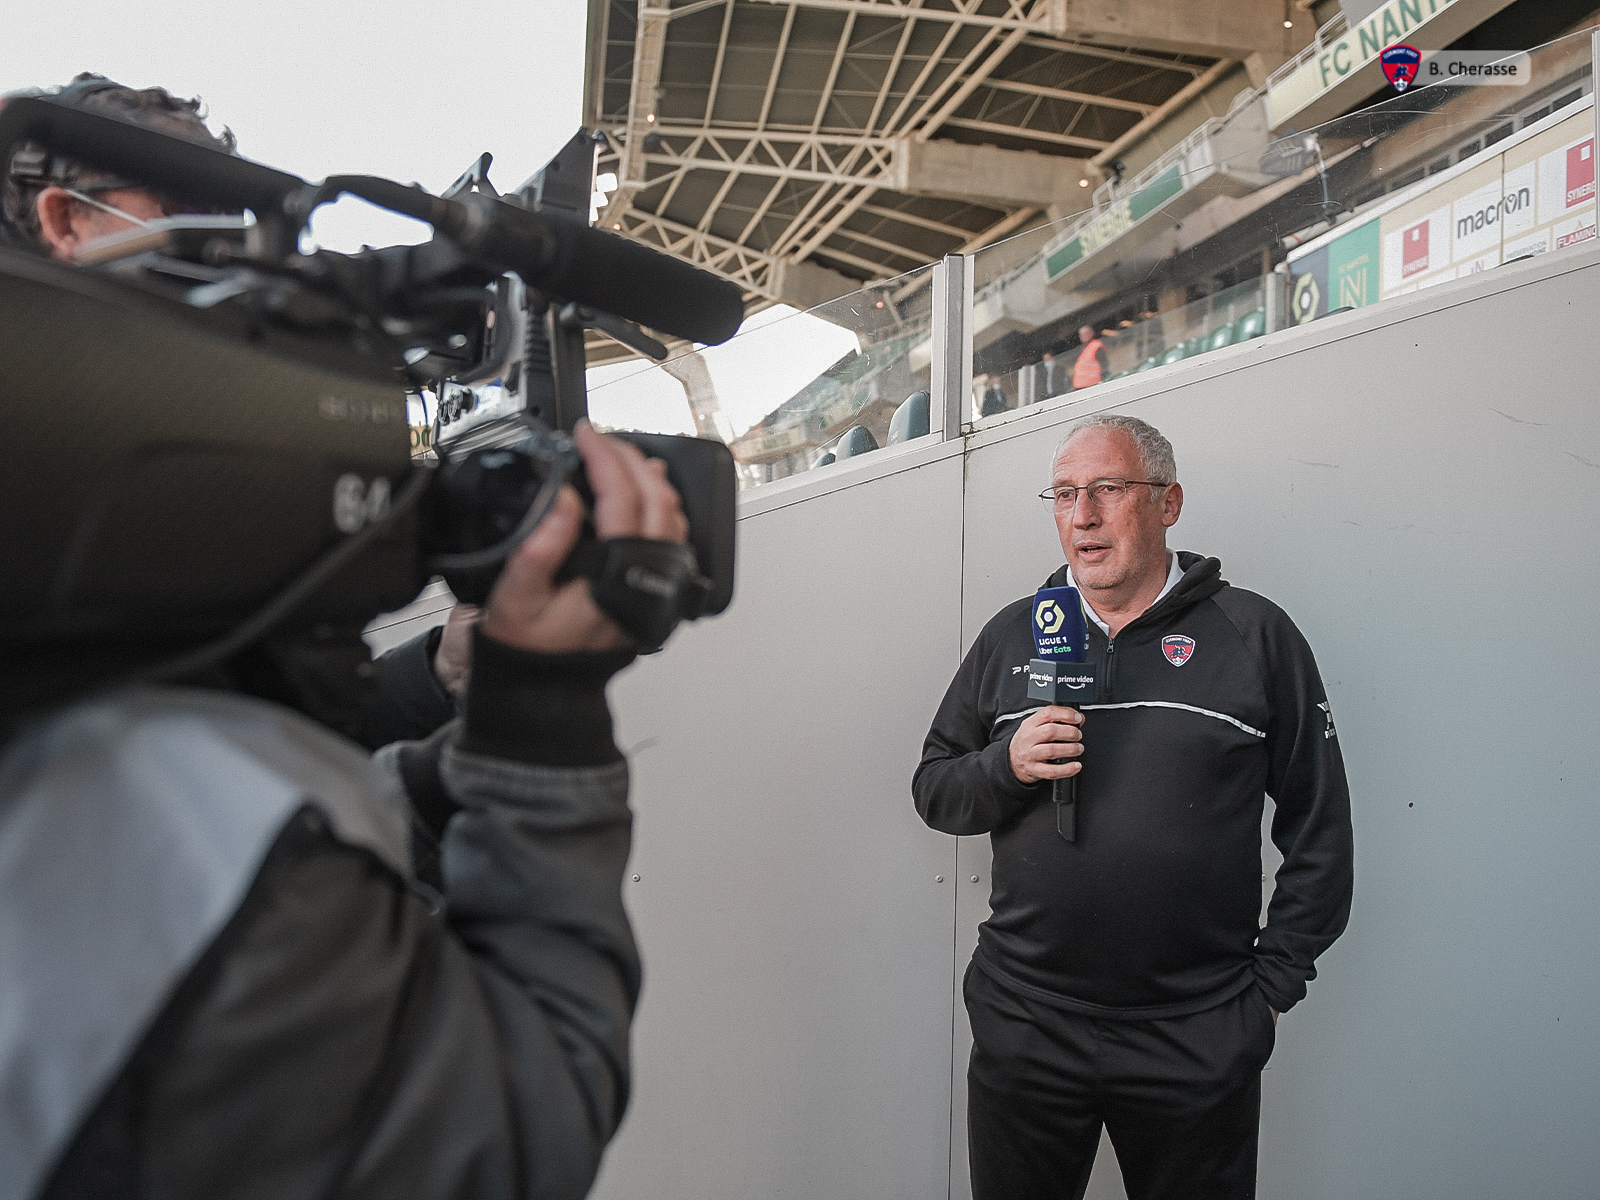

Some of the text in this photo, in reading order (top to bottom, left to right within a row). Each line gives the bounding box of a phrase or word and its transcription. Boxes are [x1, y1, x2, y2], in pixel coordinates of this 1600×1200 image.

[1319, 42, 1352, 88] FC
[1457, 186, 1530, 240] macron
[1038, 636, 1062, 646] LIGUE
[1038, 645, 1072, 655] Uber Eats
[1029, 672, 1042, 681] prime
[1057, 675, 1094, 684] prime video
